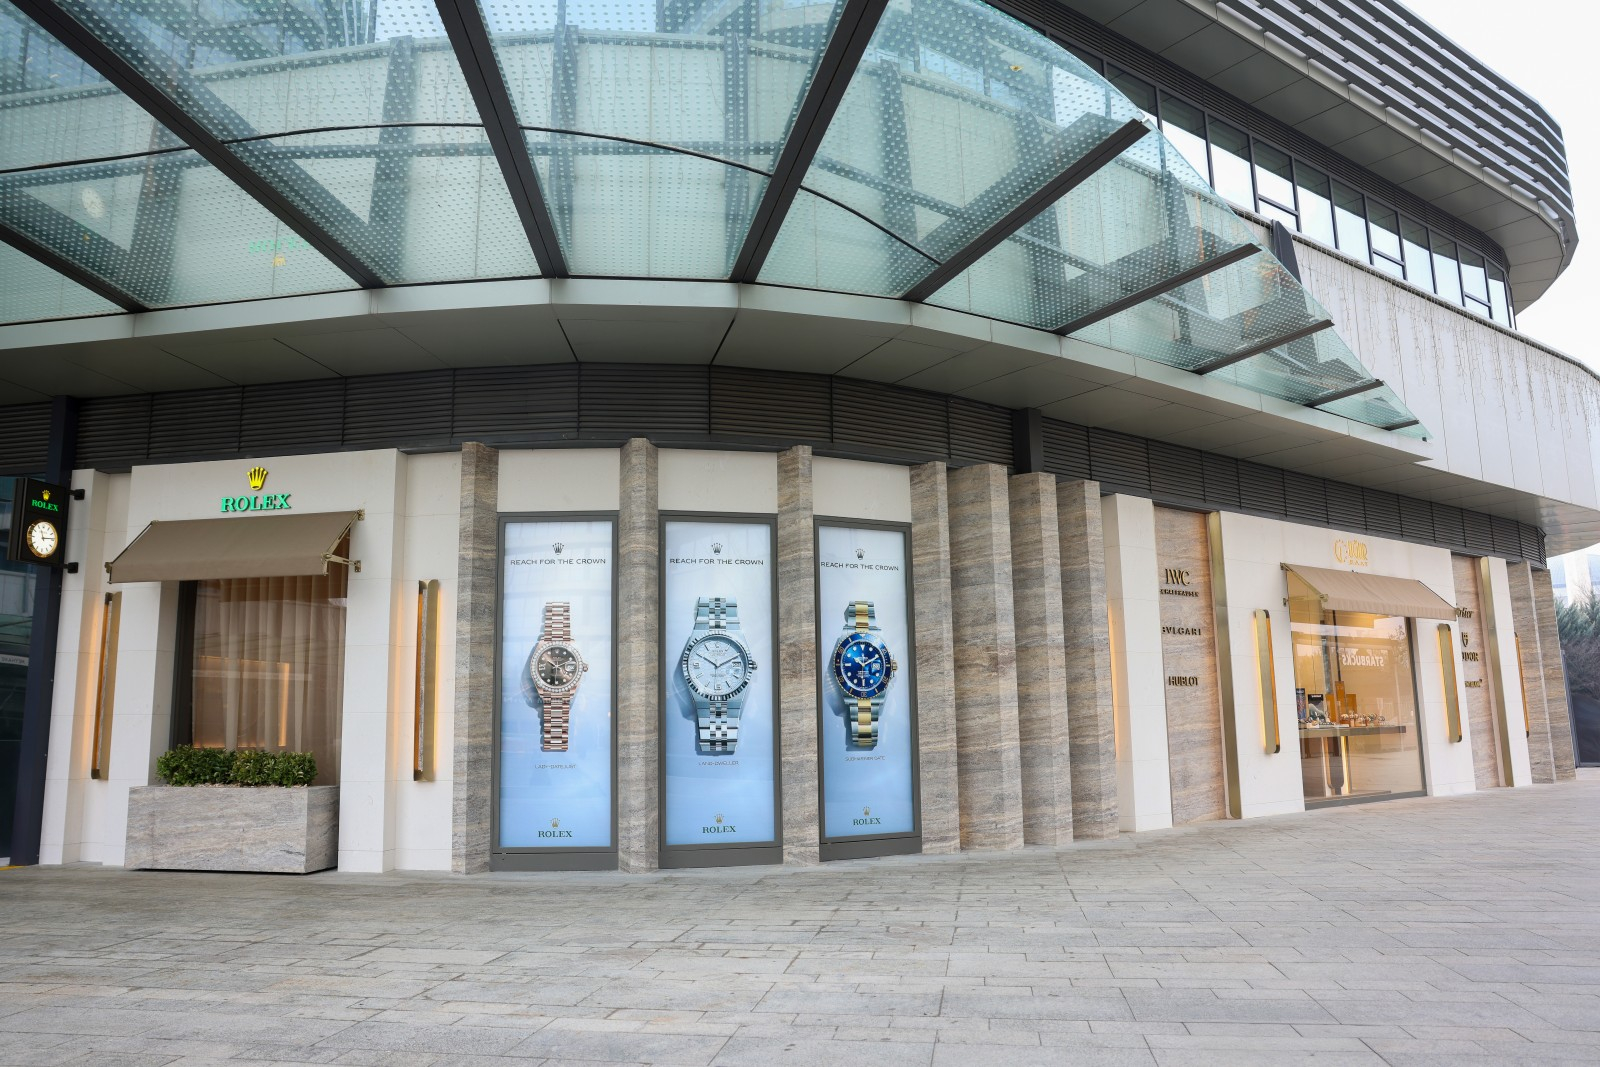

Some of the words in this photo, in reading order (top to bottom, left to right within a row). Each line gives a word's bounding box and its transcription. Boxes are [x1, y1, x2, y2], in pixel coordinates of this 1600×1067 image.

[32, 499, 59, 512] ROLEX
[220, 494, 291, 512] ROLEX
[1165, 568, 1191, 586] IWC
[1168, 675, 1199, 687] HUBLOT
[852, 817, 881, 825] ROLEX
[538, 830, 572, 838] ROLEX
[702, 825, 736, 833] ROLEX
